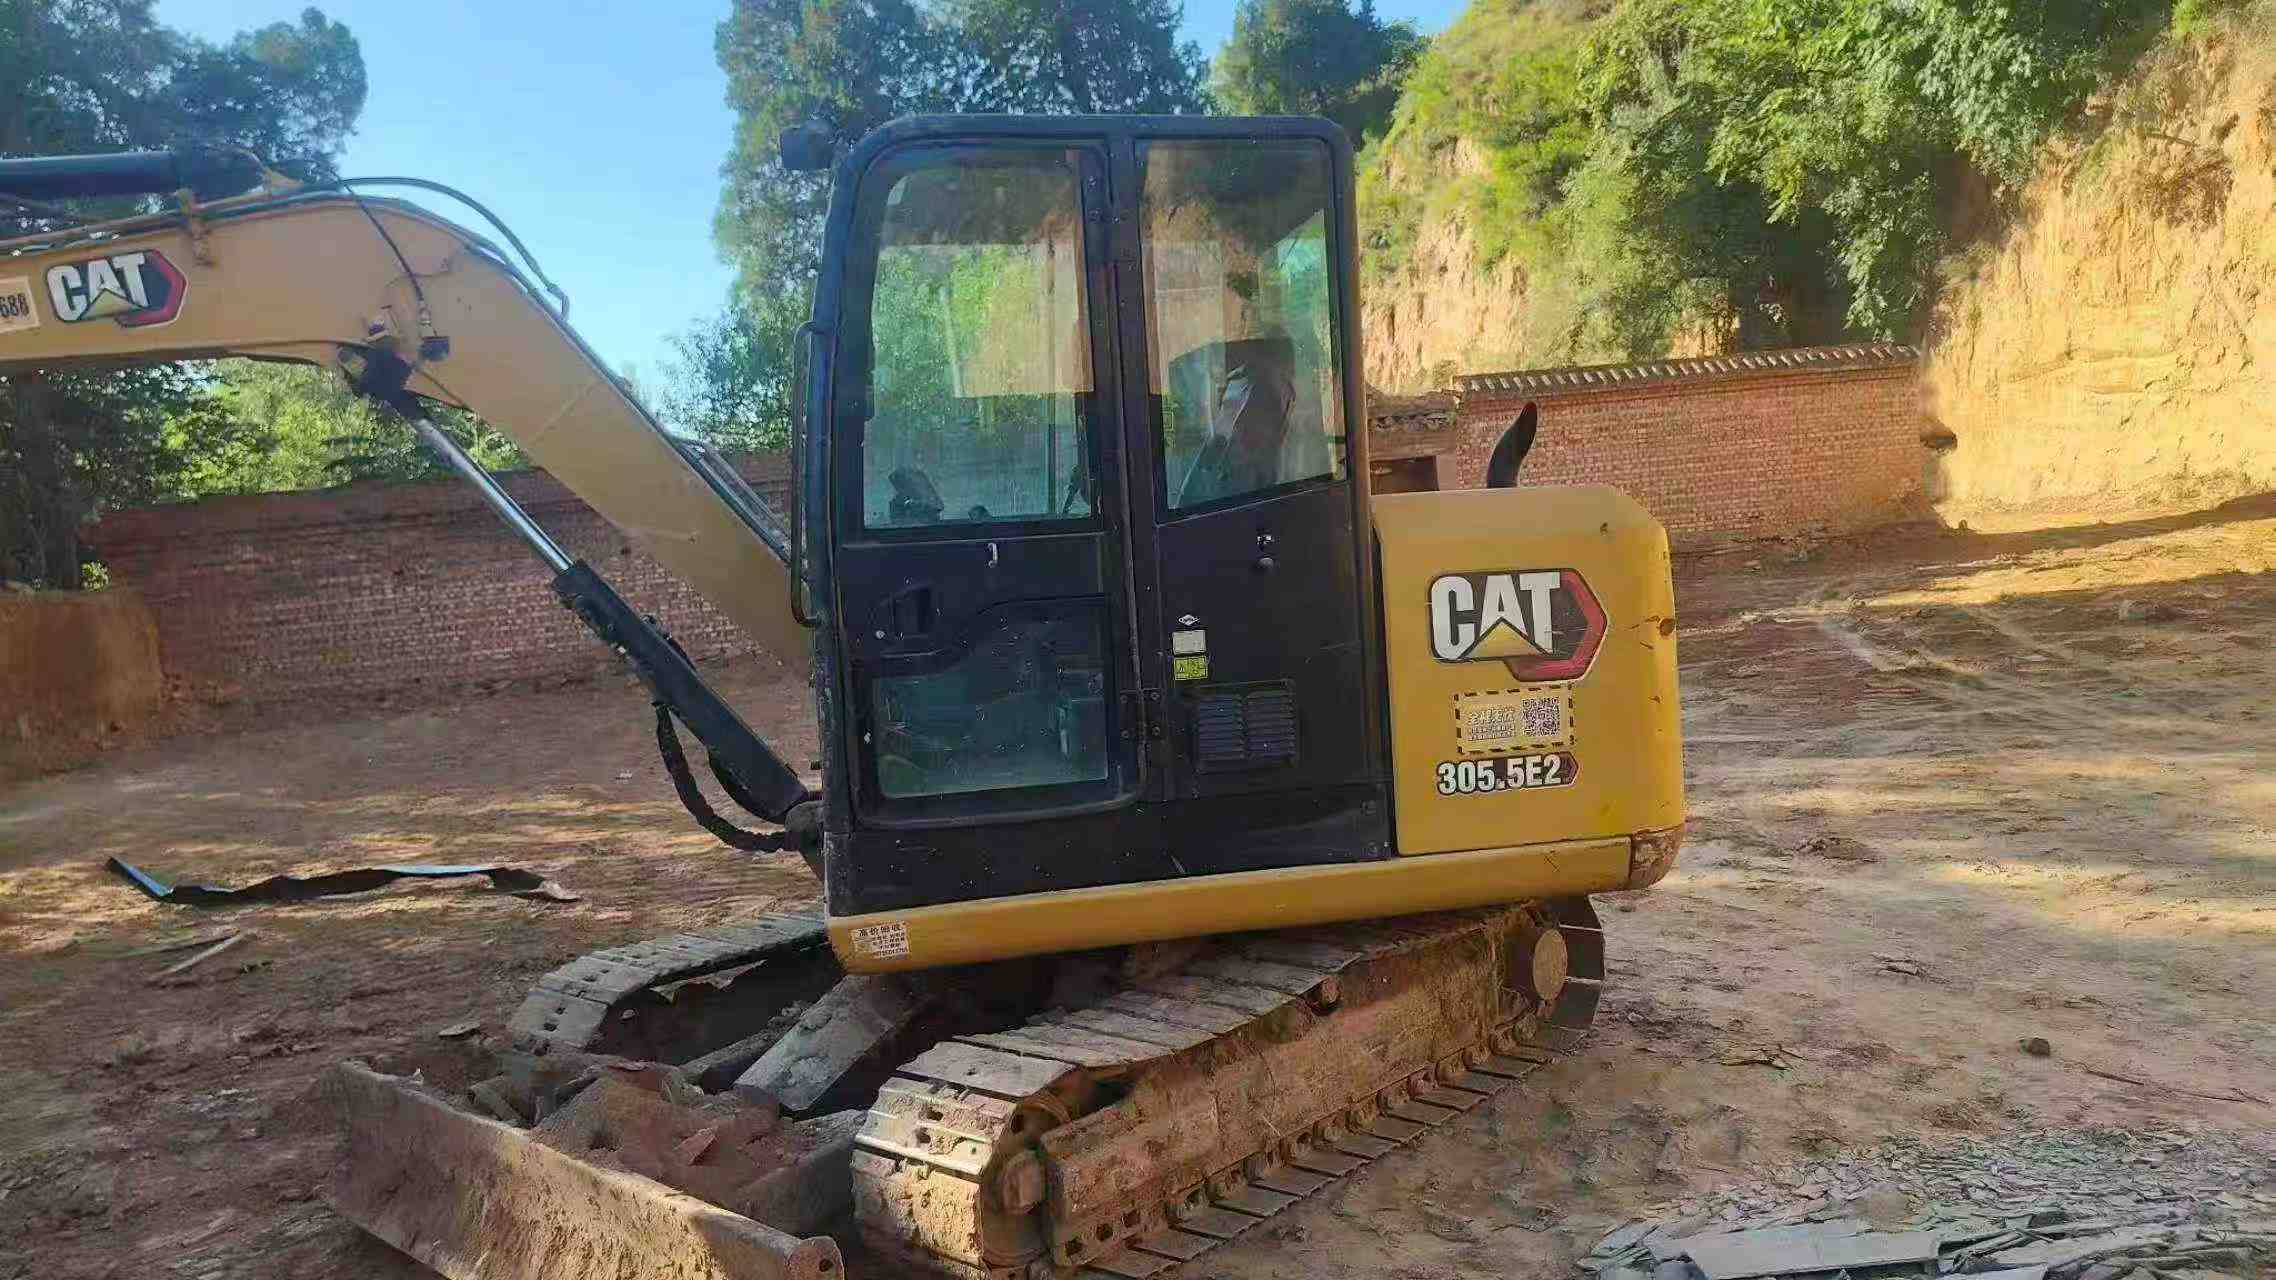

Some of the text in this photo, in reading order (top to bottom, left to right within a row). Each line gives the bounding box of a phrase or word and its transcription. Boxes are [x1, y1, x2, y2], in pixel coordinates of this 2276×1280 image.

[47, 252, 149, 321] CAT
[1431, 571, 1561, 660] CAT
[1437, 754, 1562, 794] 305.5E2
